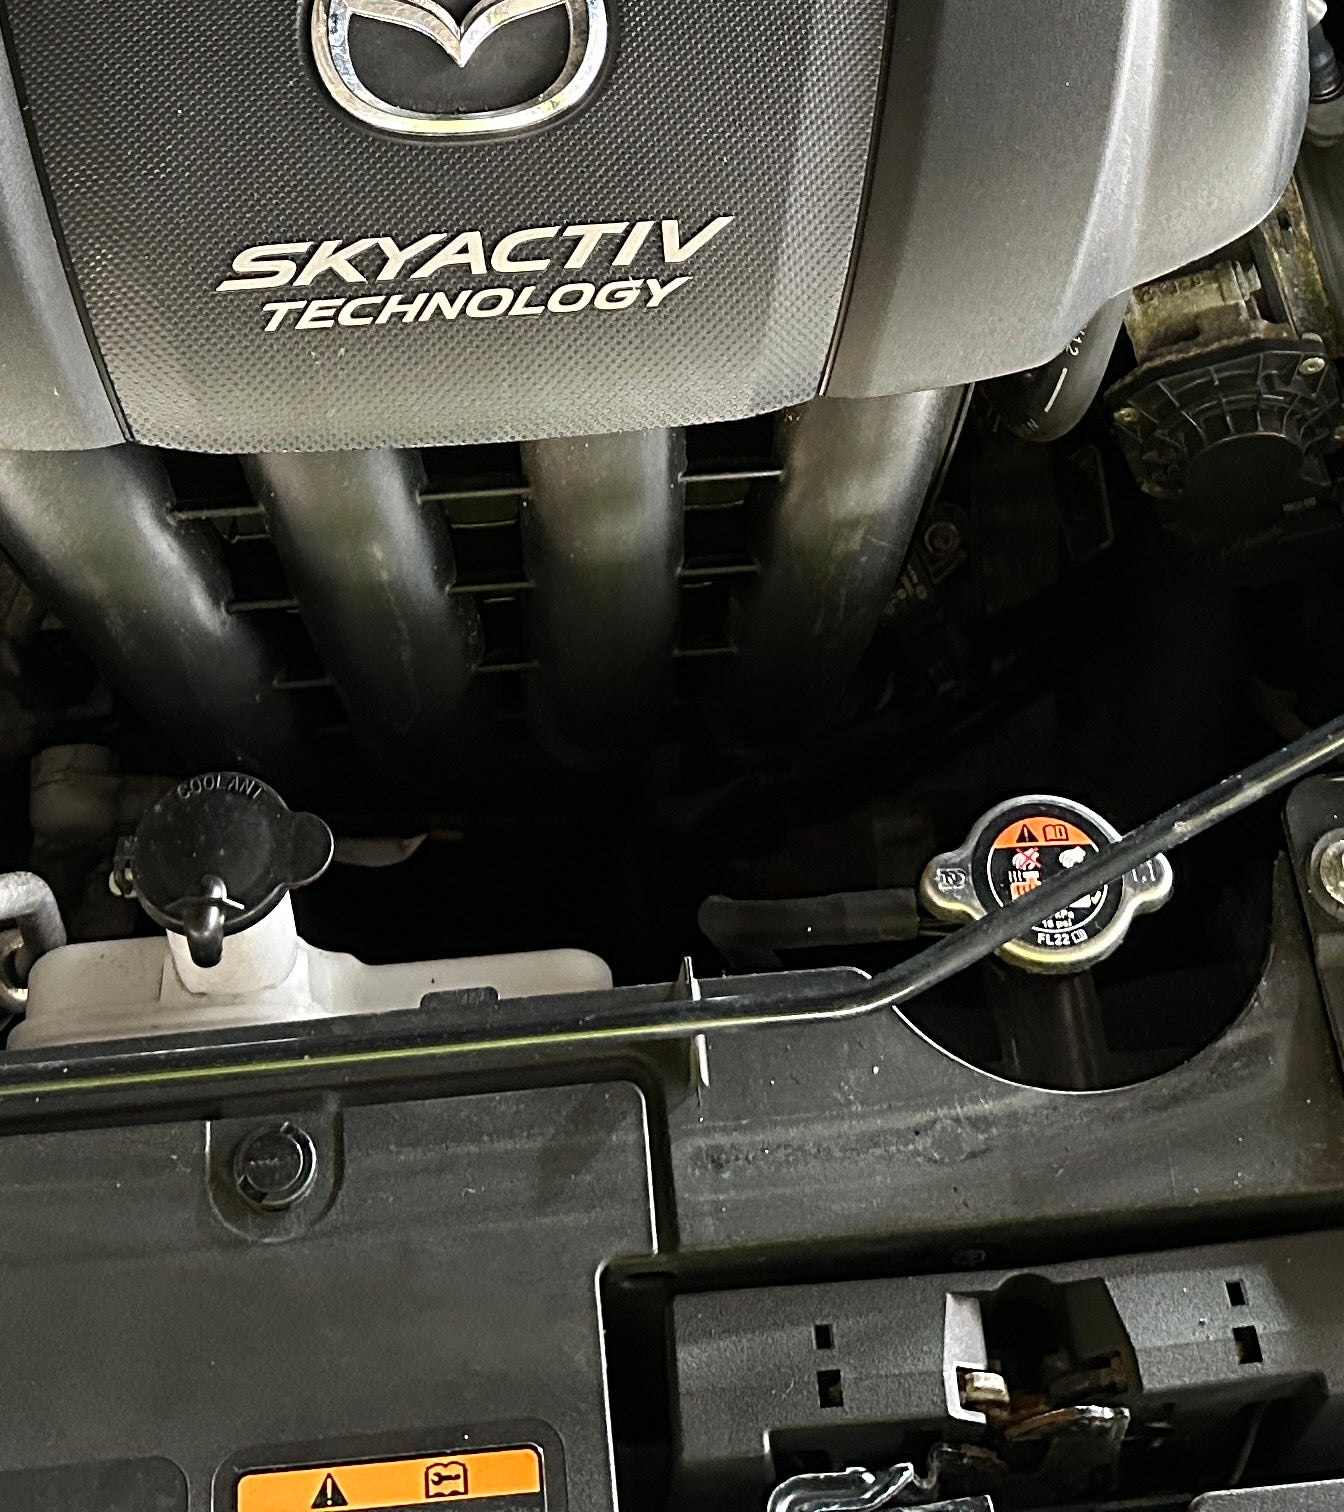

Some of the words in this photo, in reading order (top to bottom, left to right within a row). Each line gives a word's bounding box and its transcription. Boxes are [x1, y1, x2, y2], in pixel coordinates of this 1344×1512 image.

[216, 216, 734, 292] SKYACTIV
[261, 276, 692, 332] TECHNOLOGY
[177, 774, 262, 799] COOLANT
[1037, 932, 1071, 946] FL22
